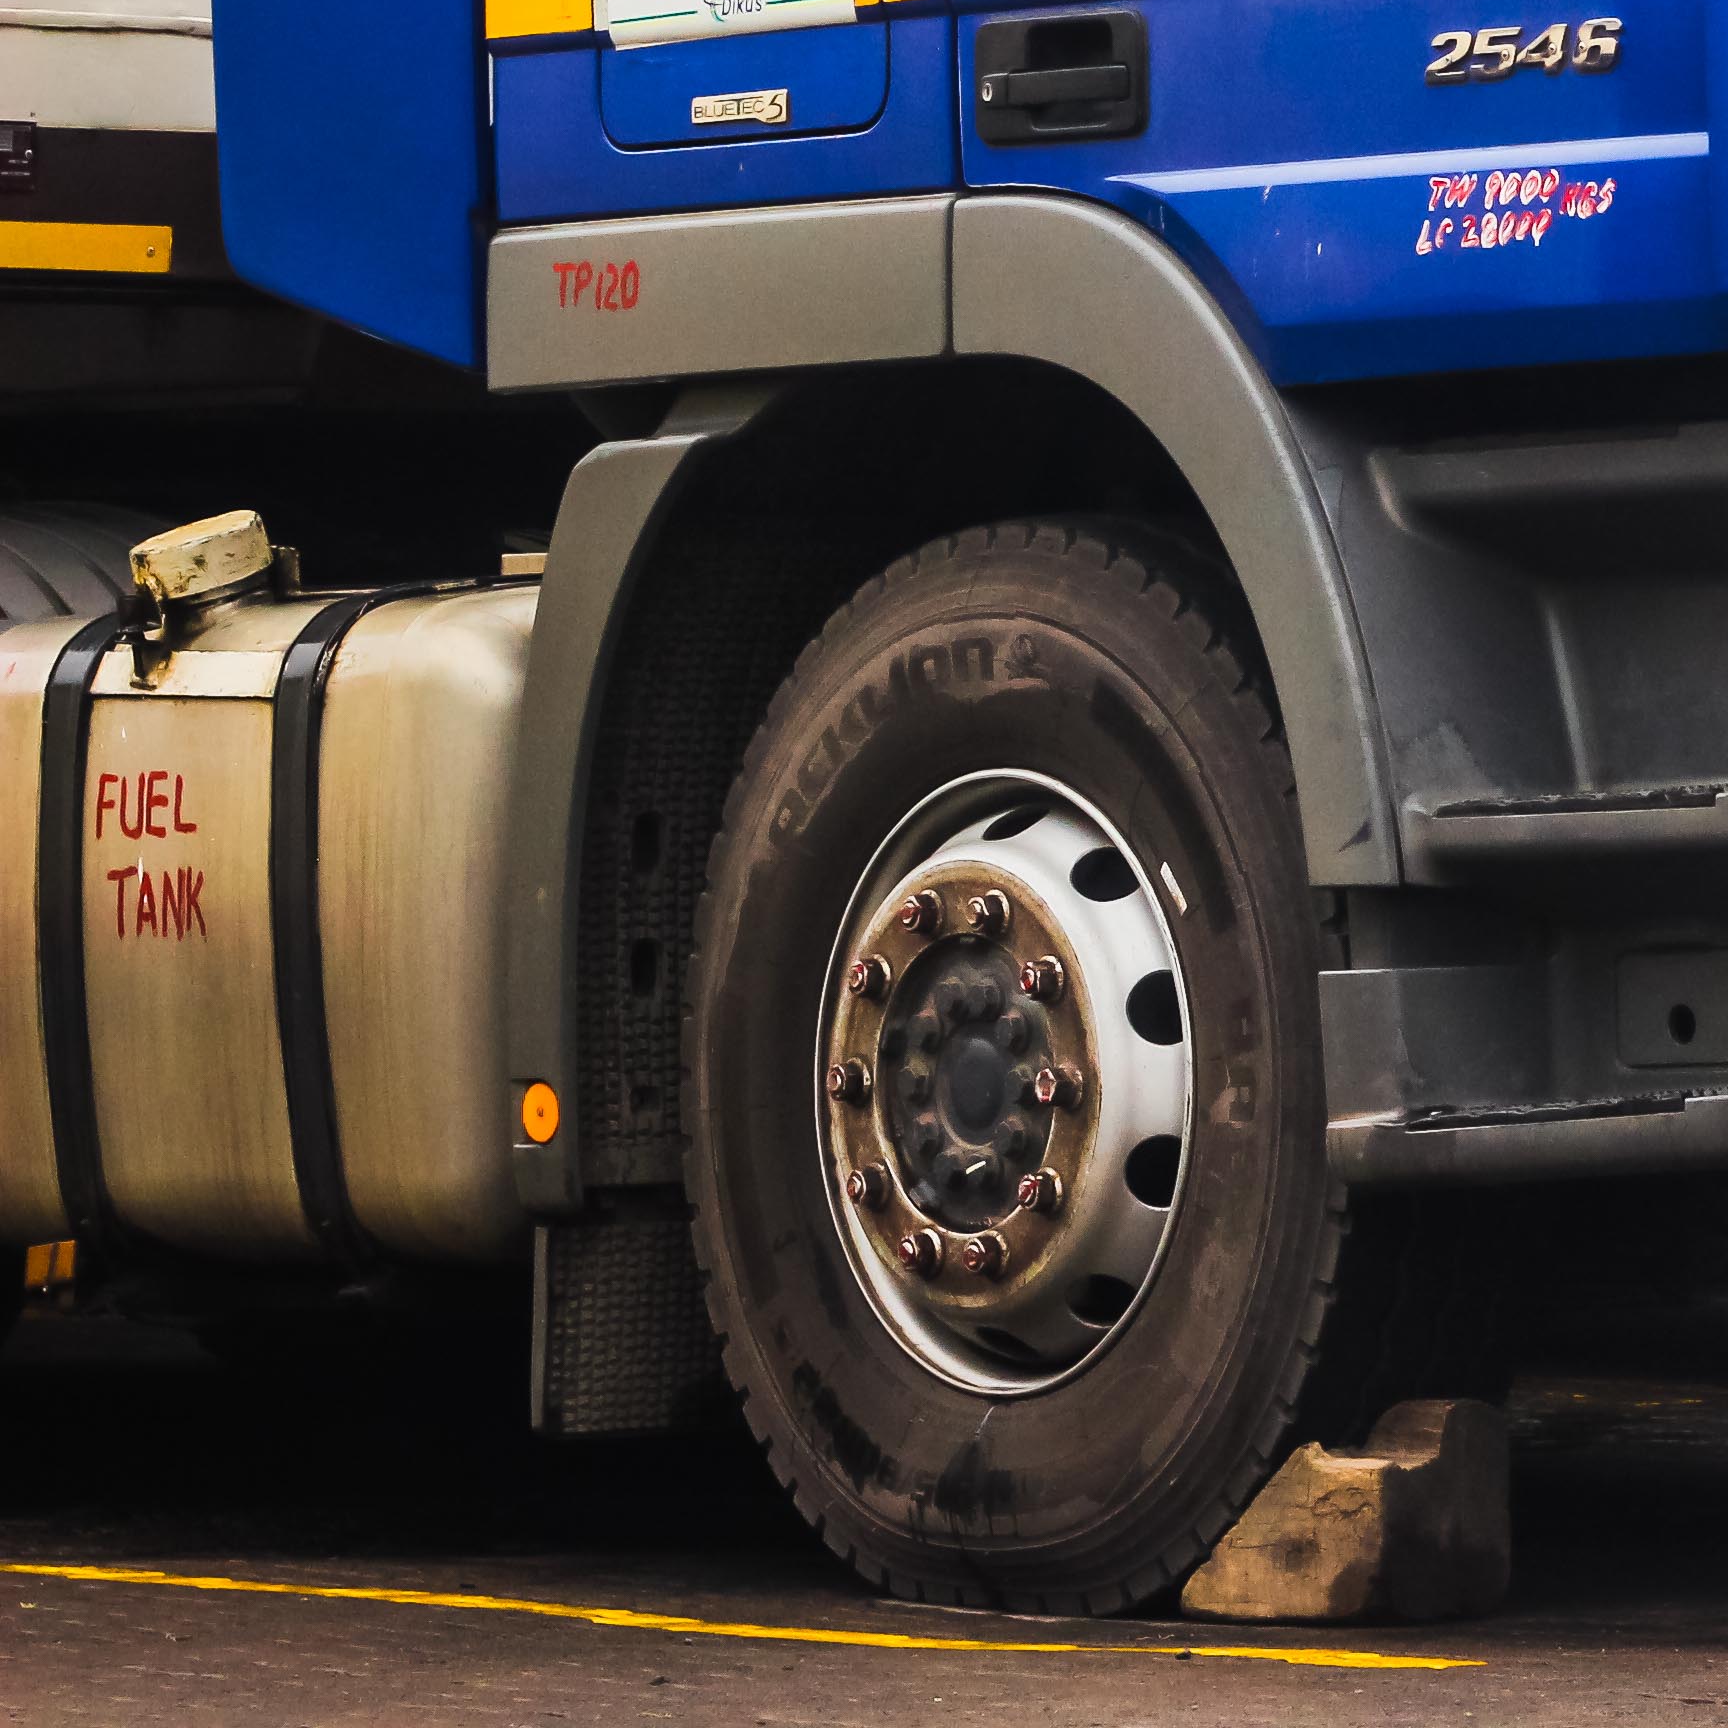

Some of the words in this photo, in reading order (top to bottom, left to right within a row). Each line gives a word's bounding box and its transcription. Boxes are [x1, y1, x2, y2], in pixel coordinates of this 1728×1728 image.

[1425, 17, 1622, 85] 2546
[694, 96, 764, 119] BLUETEC
[95, 770, 197, 840] FUEL
[107, 865, 207, 941] TANK
